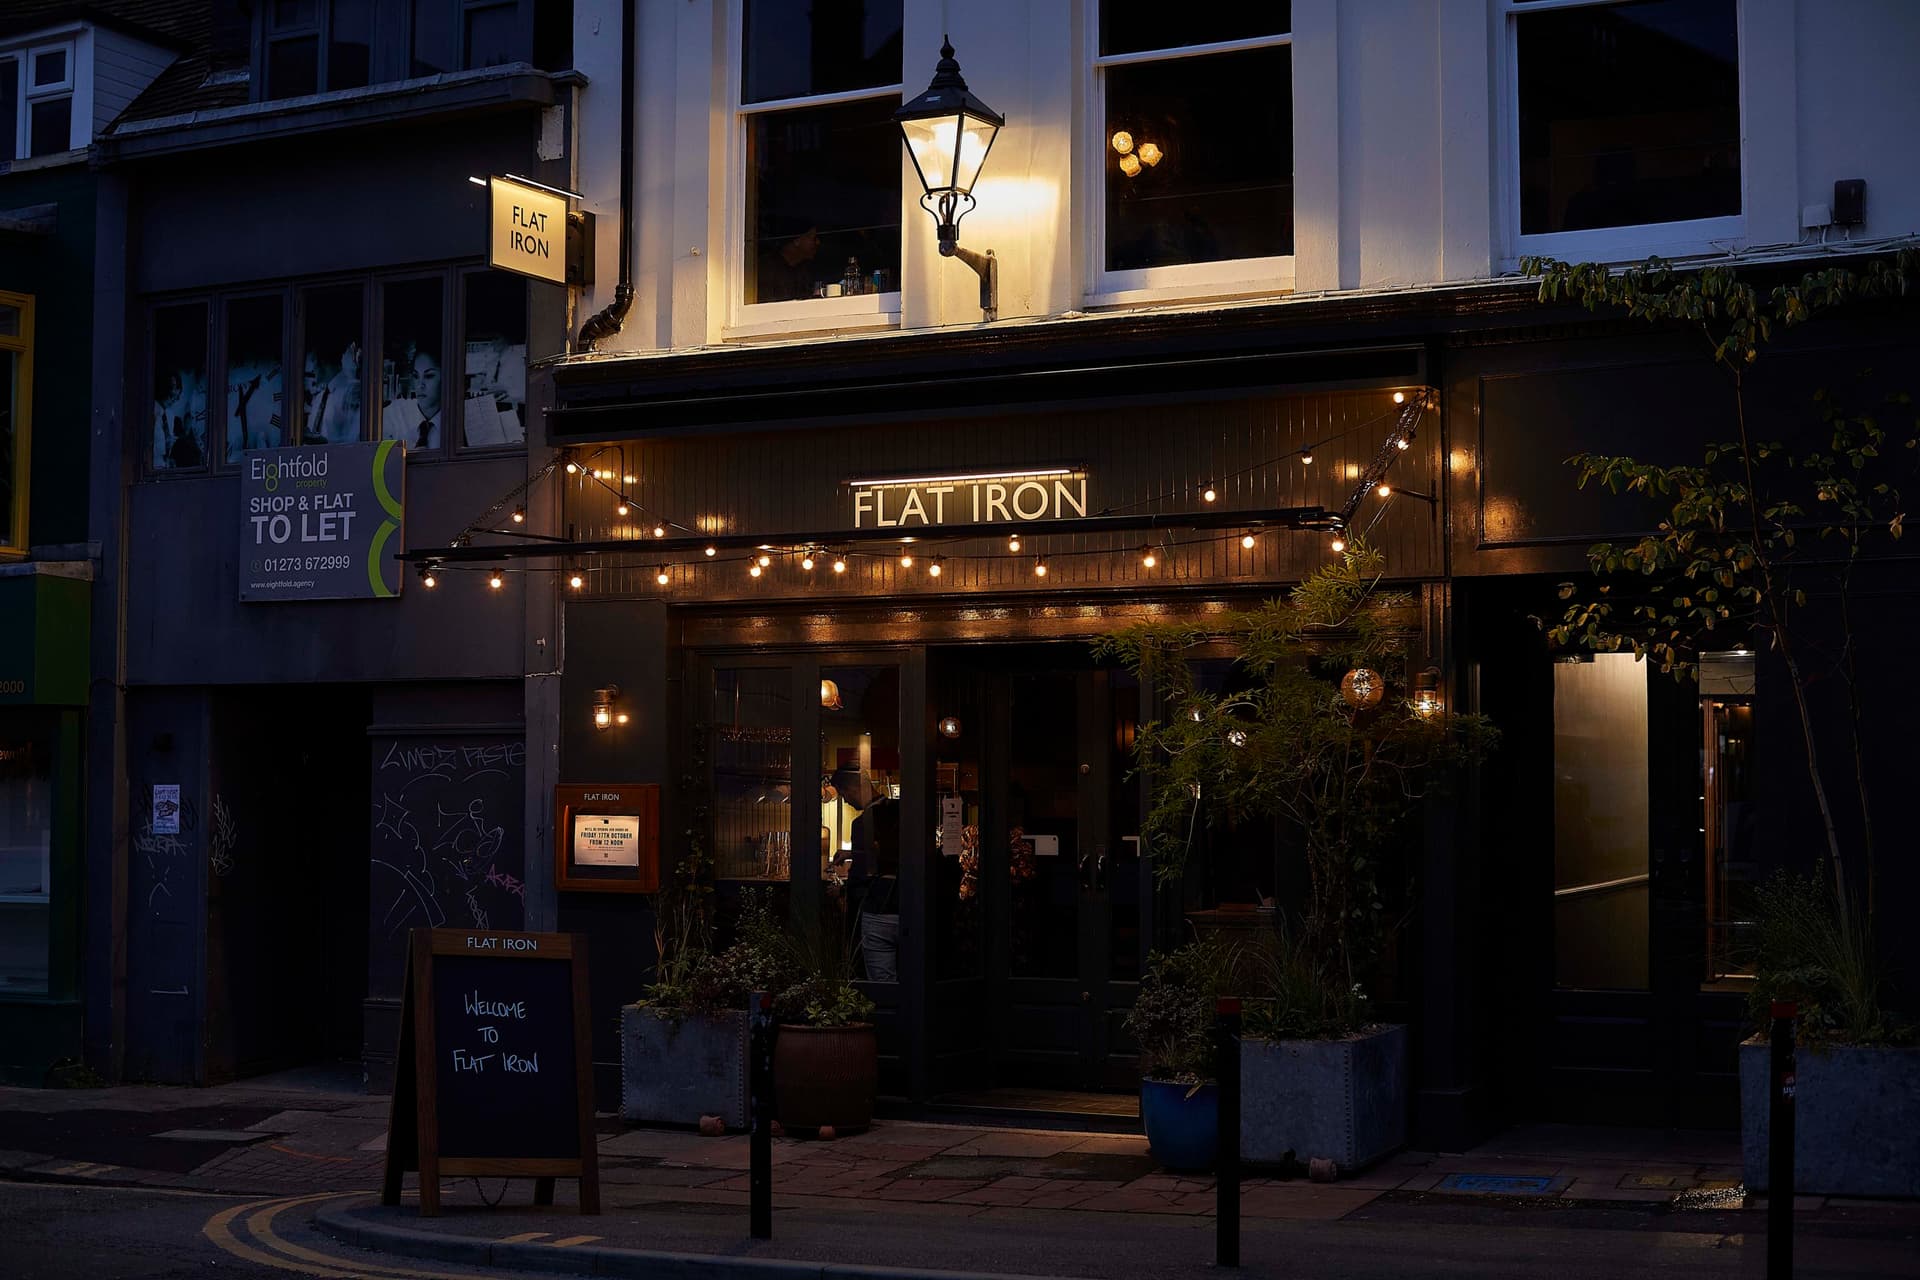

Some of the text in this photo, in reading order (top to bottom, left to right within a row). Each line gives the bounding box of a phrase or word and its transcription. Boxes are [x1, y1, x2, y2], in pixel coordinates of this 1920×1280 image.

[512, 205, 548, 233] FLAT
[510, 230, 549, 259] IRON
[296, 479, 328, 488] property
[249, 493, 354, 513] SHOP & FLAT
[854, 479, 1086, 528] FLAT IRON
[250, 511, 356, 544] TO LET
[264, 555, 351, 572] 01273 672999
[250, 580, 315, 589] www.eightfold.agency
[584, 793, 620, 801] FLAT IRON
[467, 937, 537, 951] FLAT IRON
[464, 989, 527, 1019] WELCOME
[477, 1026, 499, 1043] TO
[453, 1049, 539, 1074] FLAT IRON
